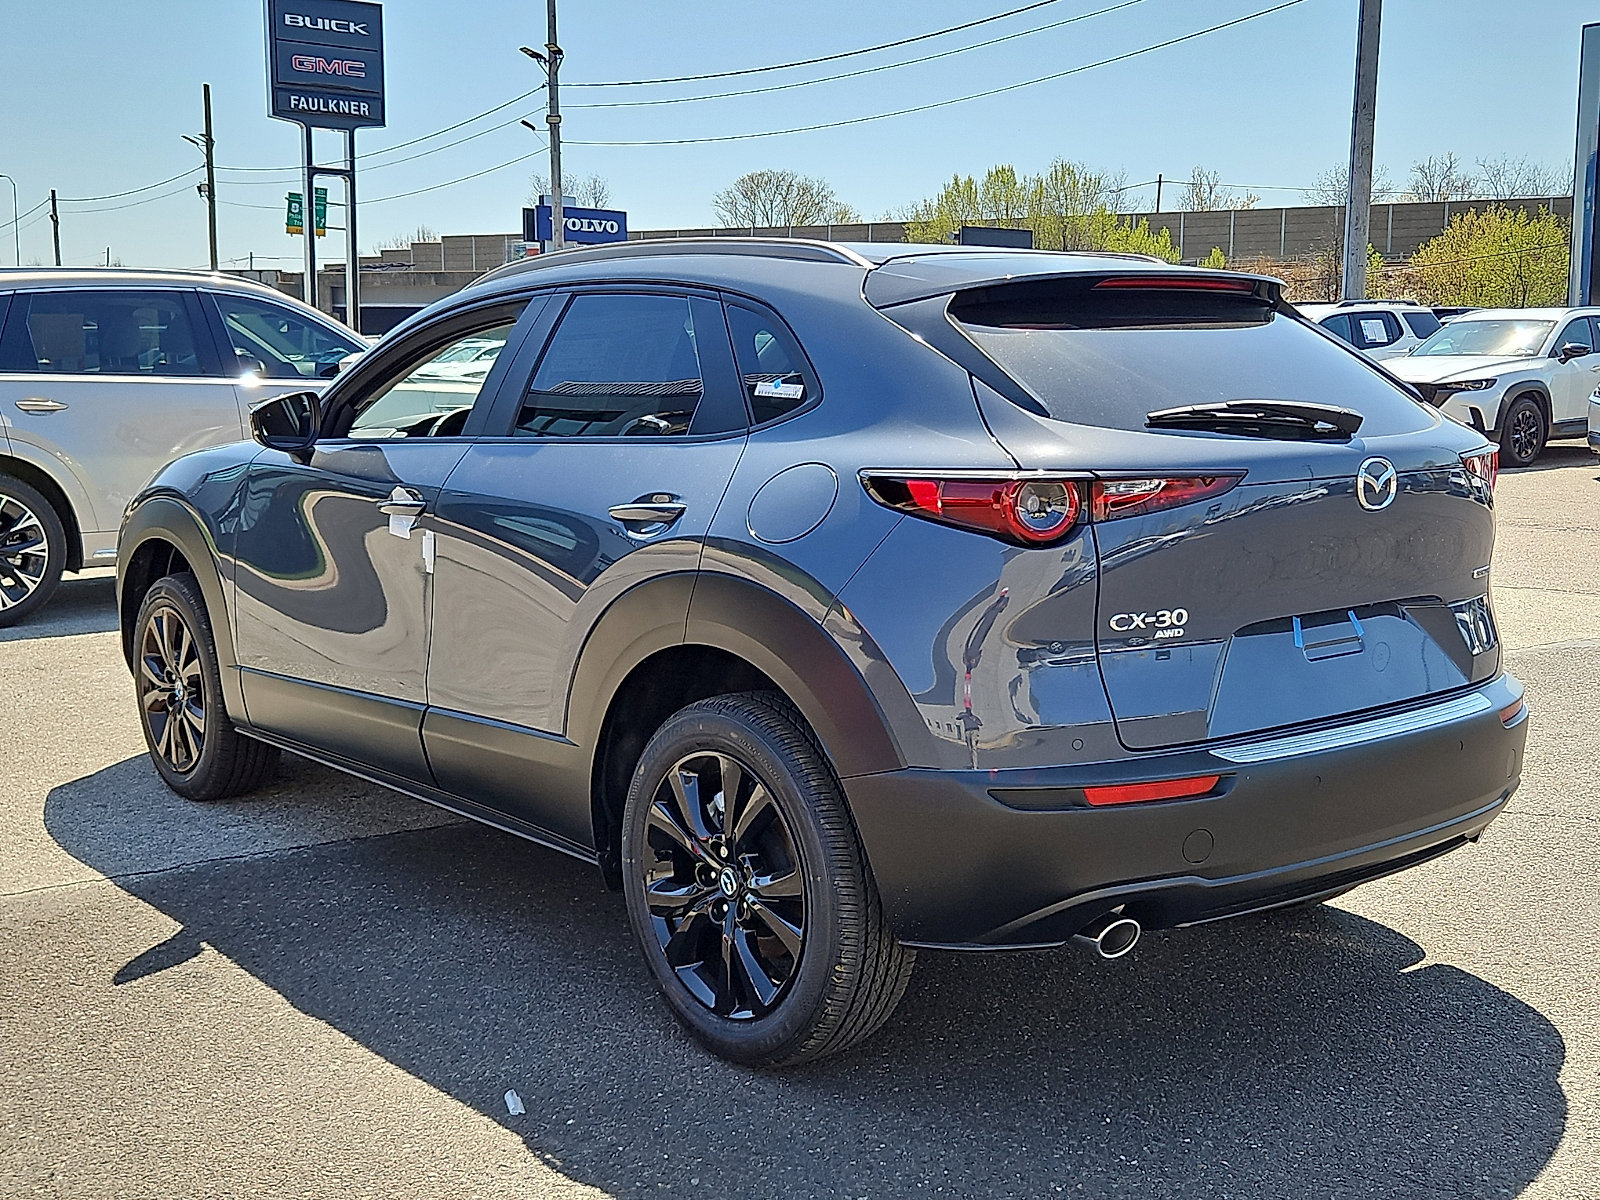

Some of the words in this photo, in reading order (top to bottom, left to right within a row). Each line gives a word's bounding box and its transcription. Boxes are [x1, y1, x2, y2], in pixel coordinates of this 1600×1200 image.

[284, 13, 370, 36] BUICK
[292, 54, 366, 78] GMC
[290, 95, 369, 116] FAULKNER
[1109, 608, 1189, 632] CX-30
[1154, 628, 1185, 639] AWD
